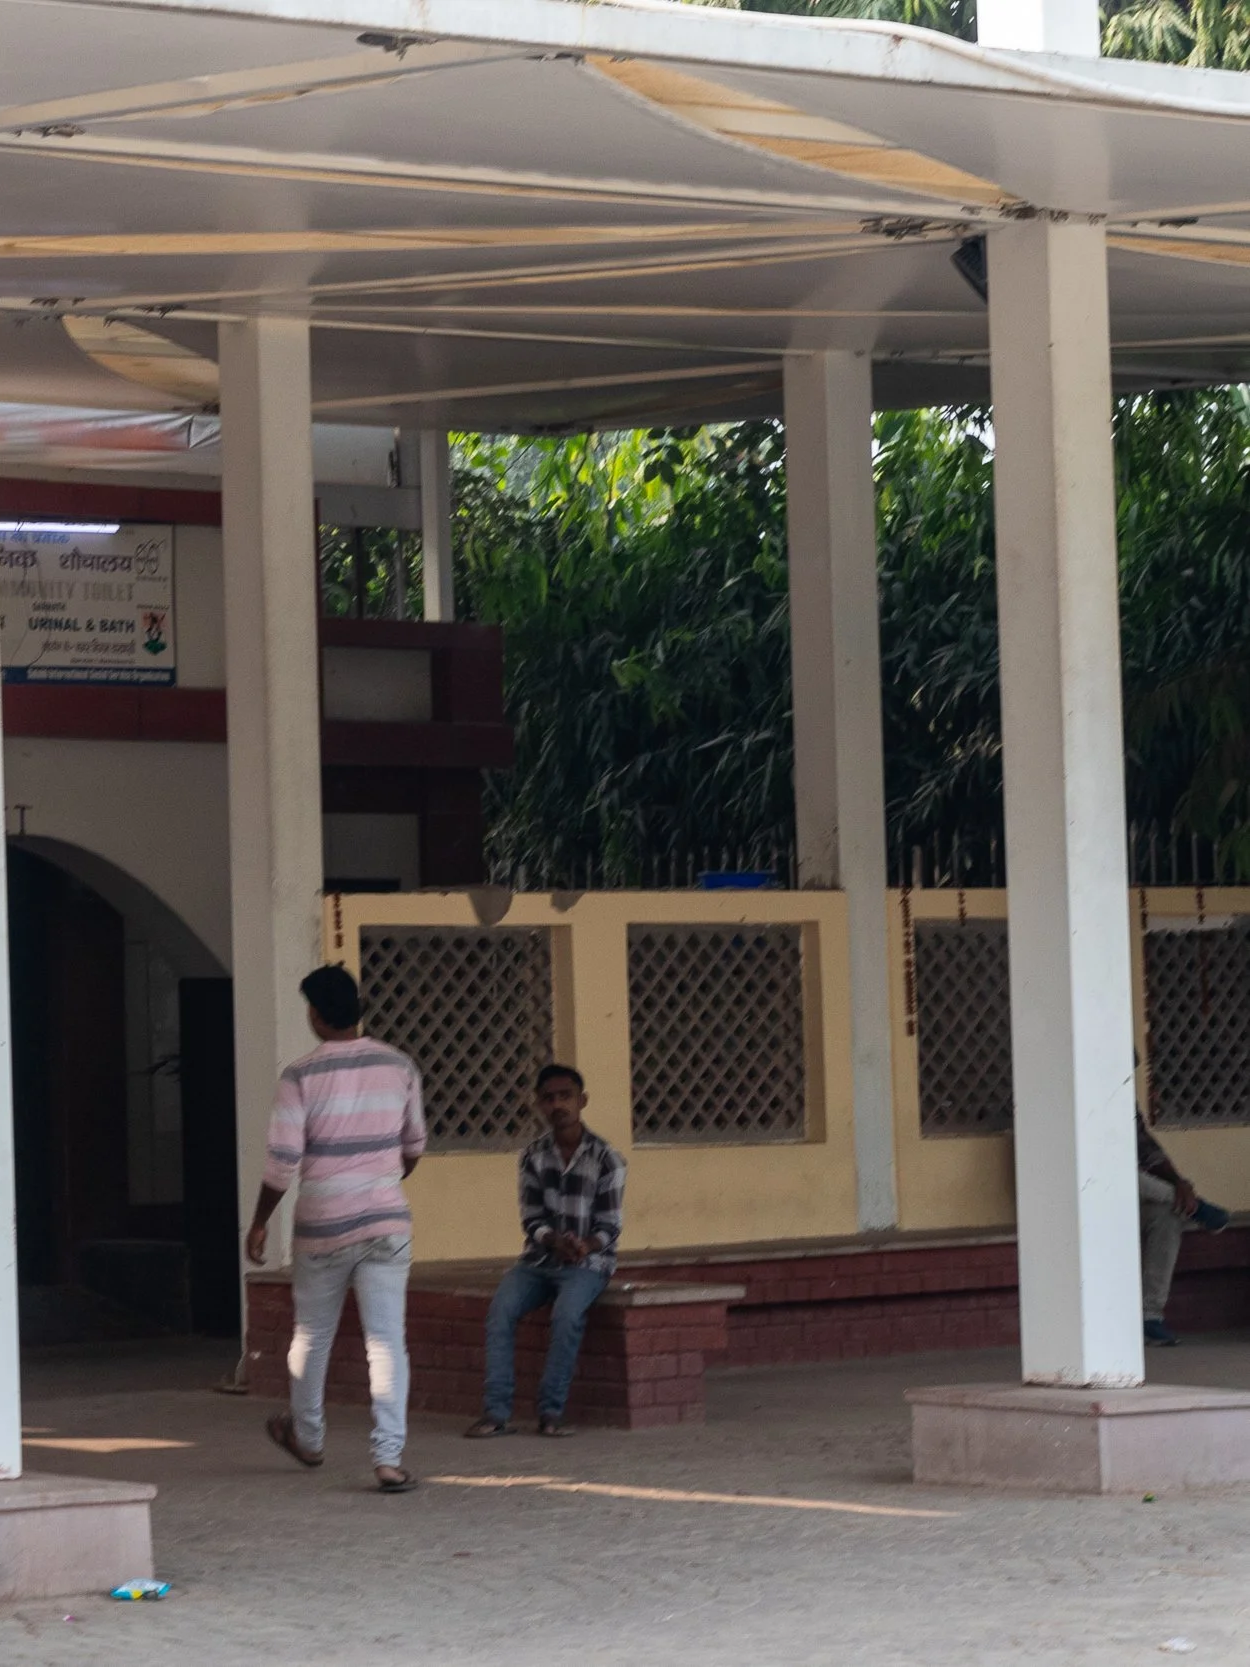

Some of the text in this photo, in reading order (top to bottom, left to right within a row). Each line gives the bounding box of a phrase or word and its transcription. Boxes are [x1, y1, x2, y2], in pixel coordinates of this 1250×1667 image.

[83, 580, 136, 602] TOILET
[27, 616, 136, 633] URINAL & BATH
